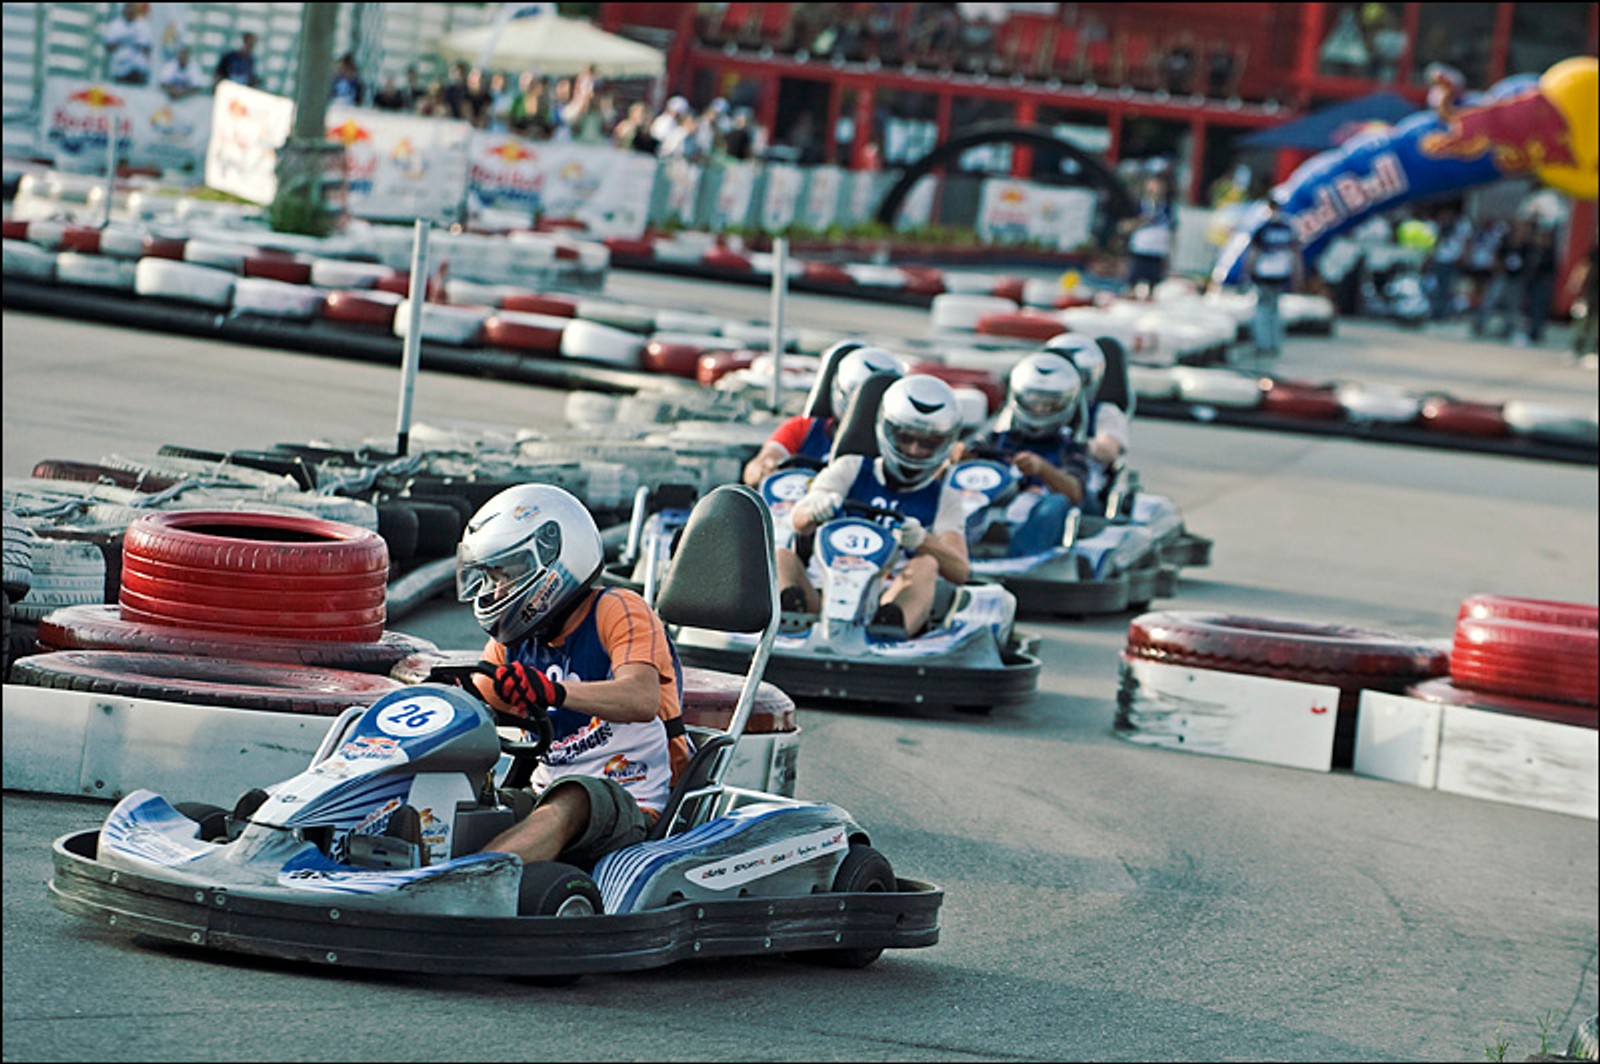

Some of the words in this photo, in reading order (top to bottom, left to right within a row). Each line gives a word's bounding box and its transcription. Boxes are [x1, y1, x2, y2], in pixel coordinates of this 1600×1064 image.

[1338, 155, 1403, 213] Bull
[845, 533, 870, 549] 31
[387, 703, 437, 729] 26
